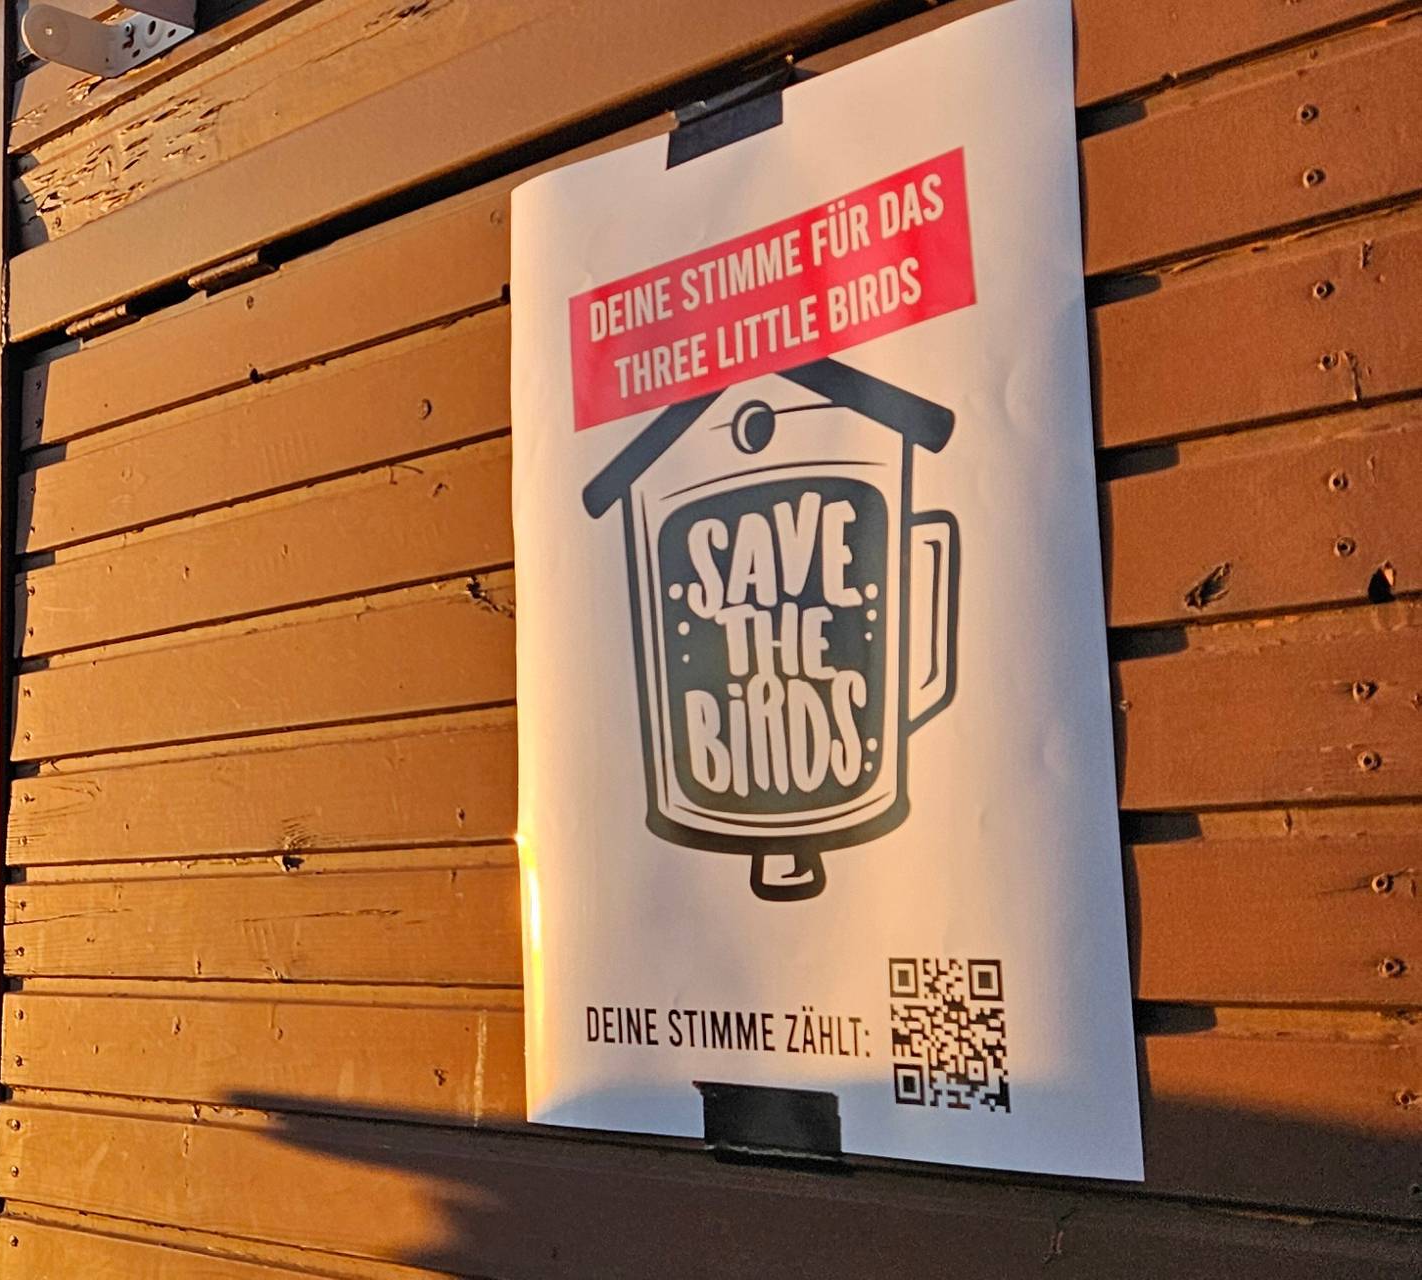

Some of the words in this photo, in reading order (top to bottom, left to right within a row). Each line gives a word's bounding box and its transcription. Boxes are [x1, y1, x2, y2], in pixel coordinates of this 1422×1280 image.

[589, 278, 672, 342] DEINE
[681, 230, 803, 311] STIMME
[811, 200, 870, 267] FÜR
[880, 174, 945, 239] DAS
[614, 332, 707, 399] THREE
[717, 296, 819, 369] LITTLE
[827, 257, 922, 333] BIRDS
[687, 492, 863, 619] SAVE
[715, 602, 835, 680] THE
[586, 1006, 659, 1046] DEINE
[667, 1009, 776, 1051] STIMME
[784, 1005, 872, 1058] ZÄHLT:
